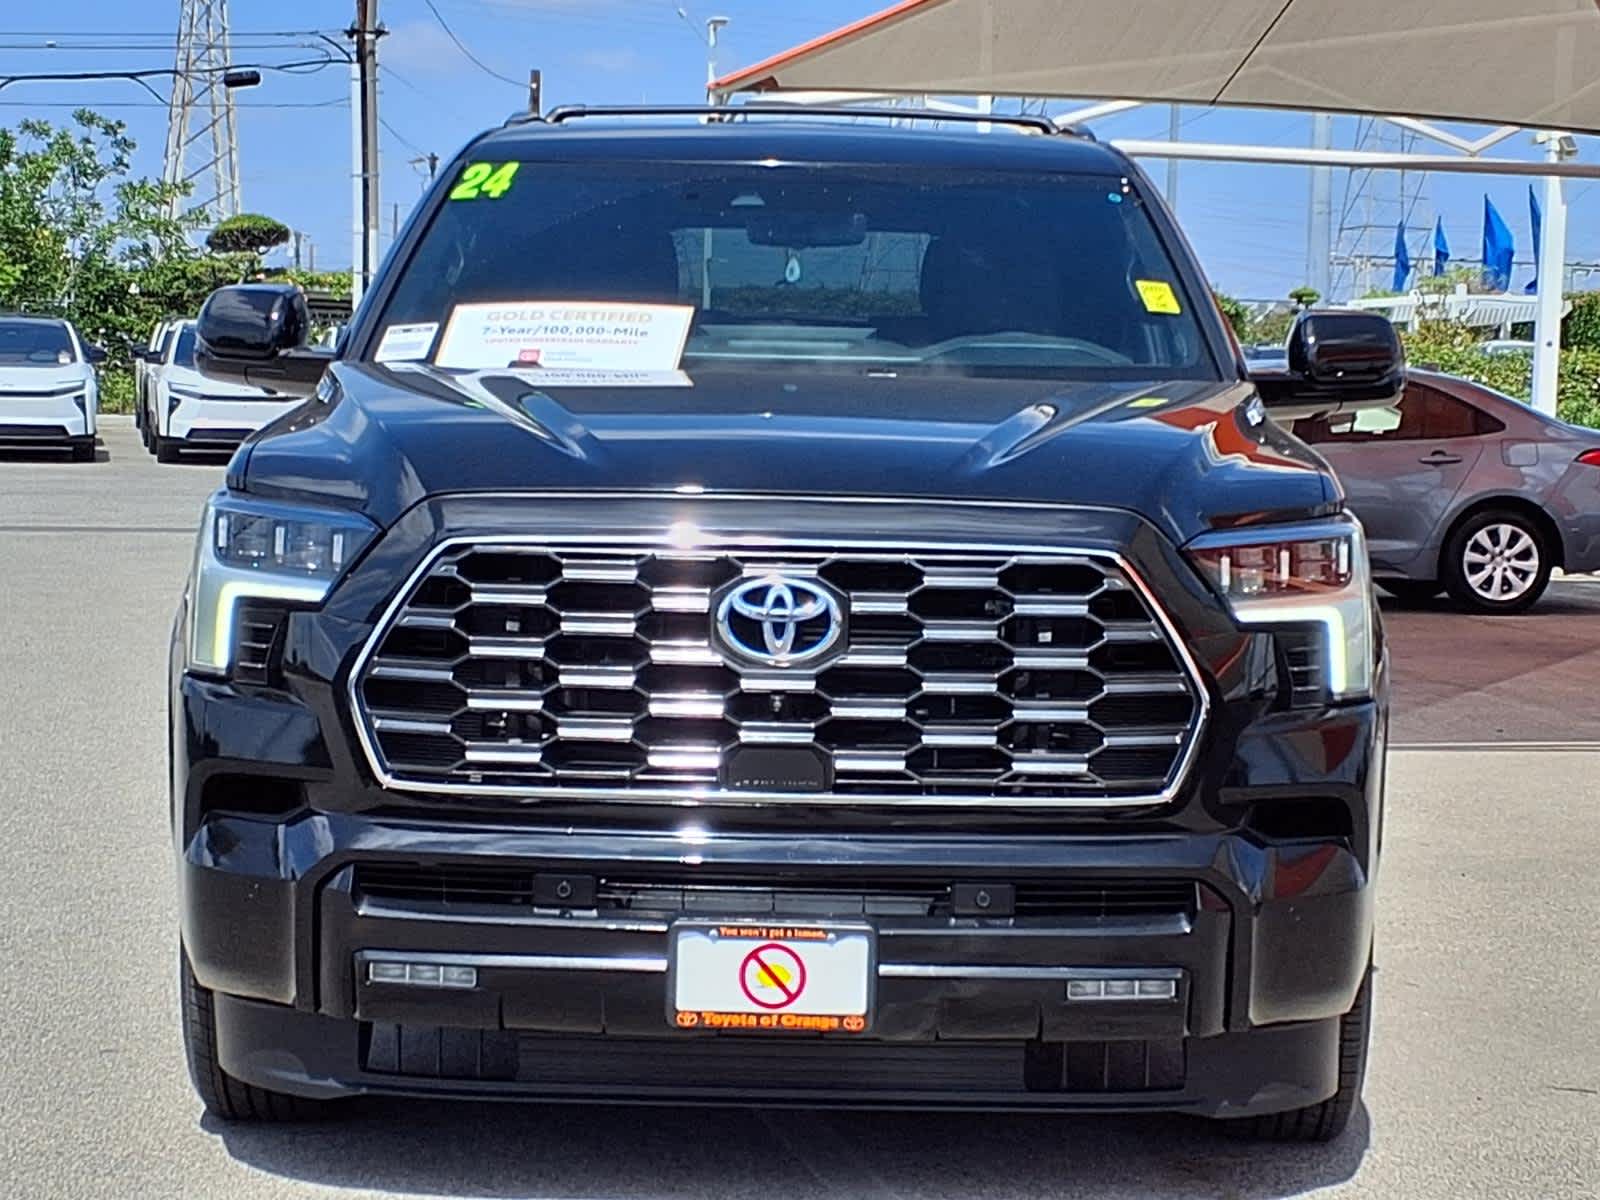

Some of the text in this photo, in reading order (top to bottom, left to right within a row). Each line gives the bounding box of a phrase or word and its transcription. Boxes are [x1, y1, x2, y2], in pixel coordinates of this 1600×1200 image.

[449, 161, 520, 200] 24
[487, 310, 653, 323] GOLD CERTIFIED
[482, 325, 649, 337] 7-Year/100,000-Mile
[720, 926, 738, 936] You
[769, 928, 784, 939] get
[702, 1012, 839, 1030] Toyota of Orange
